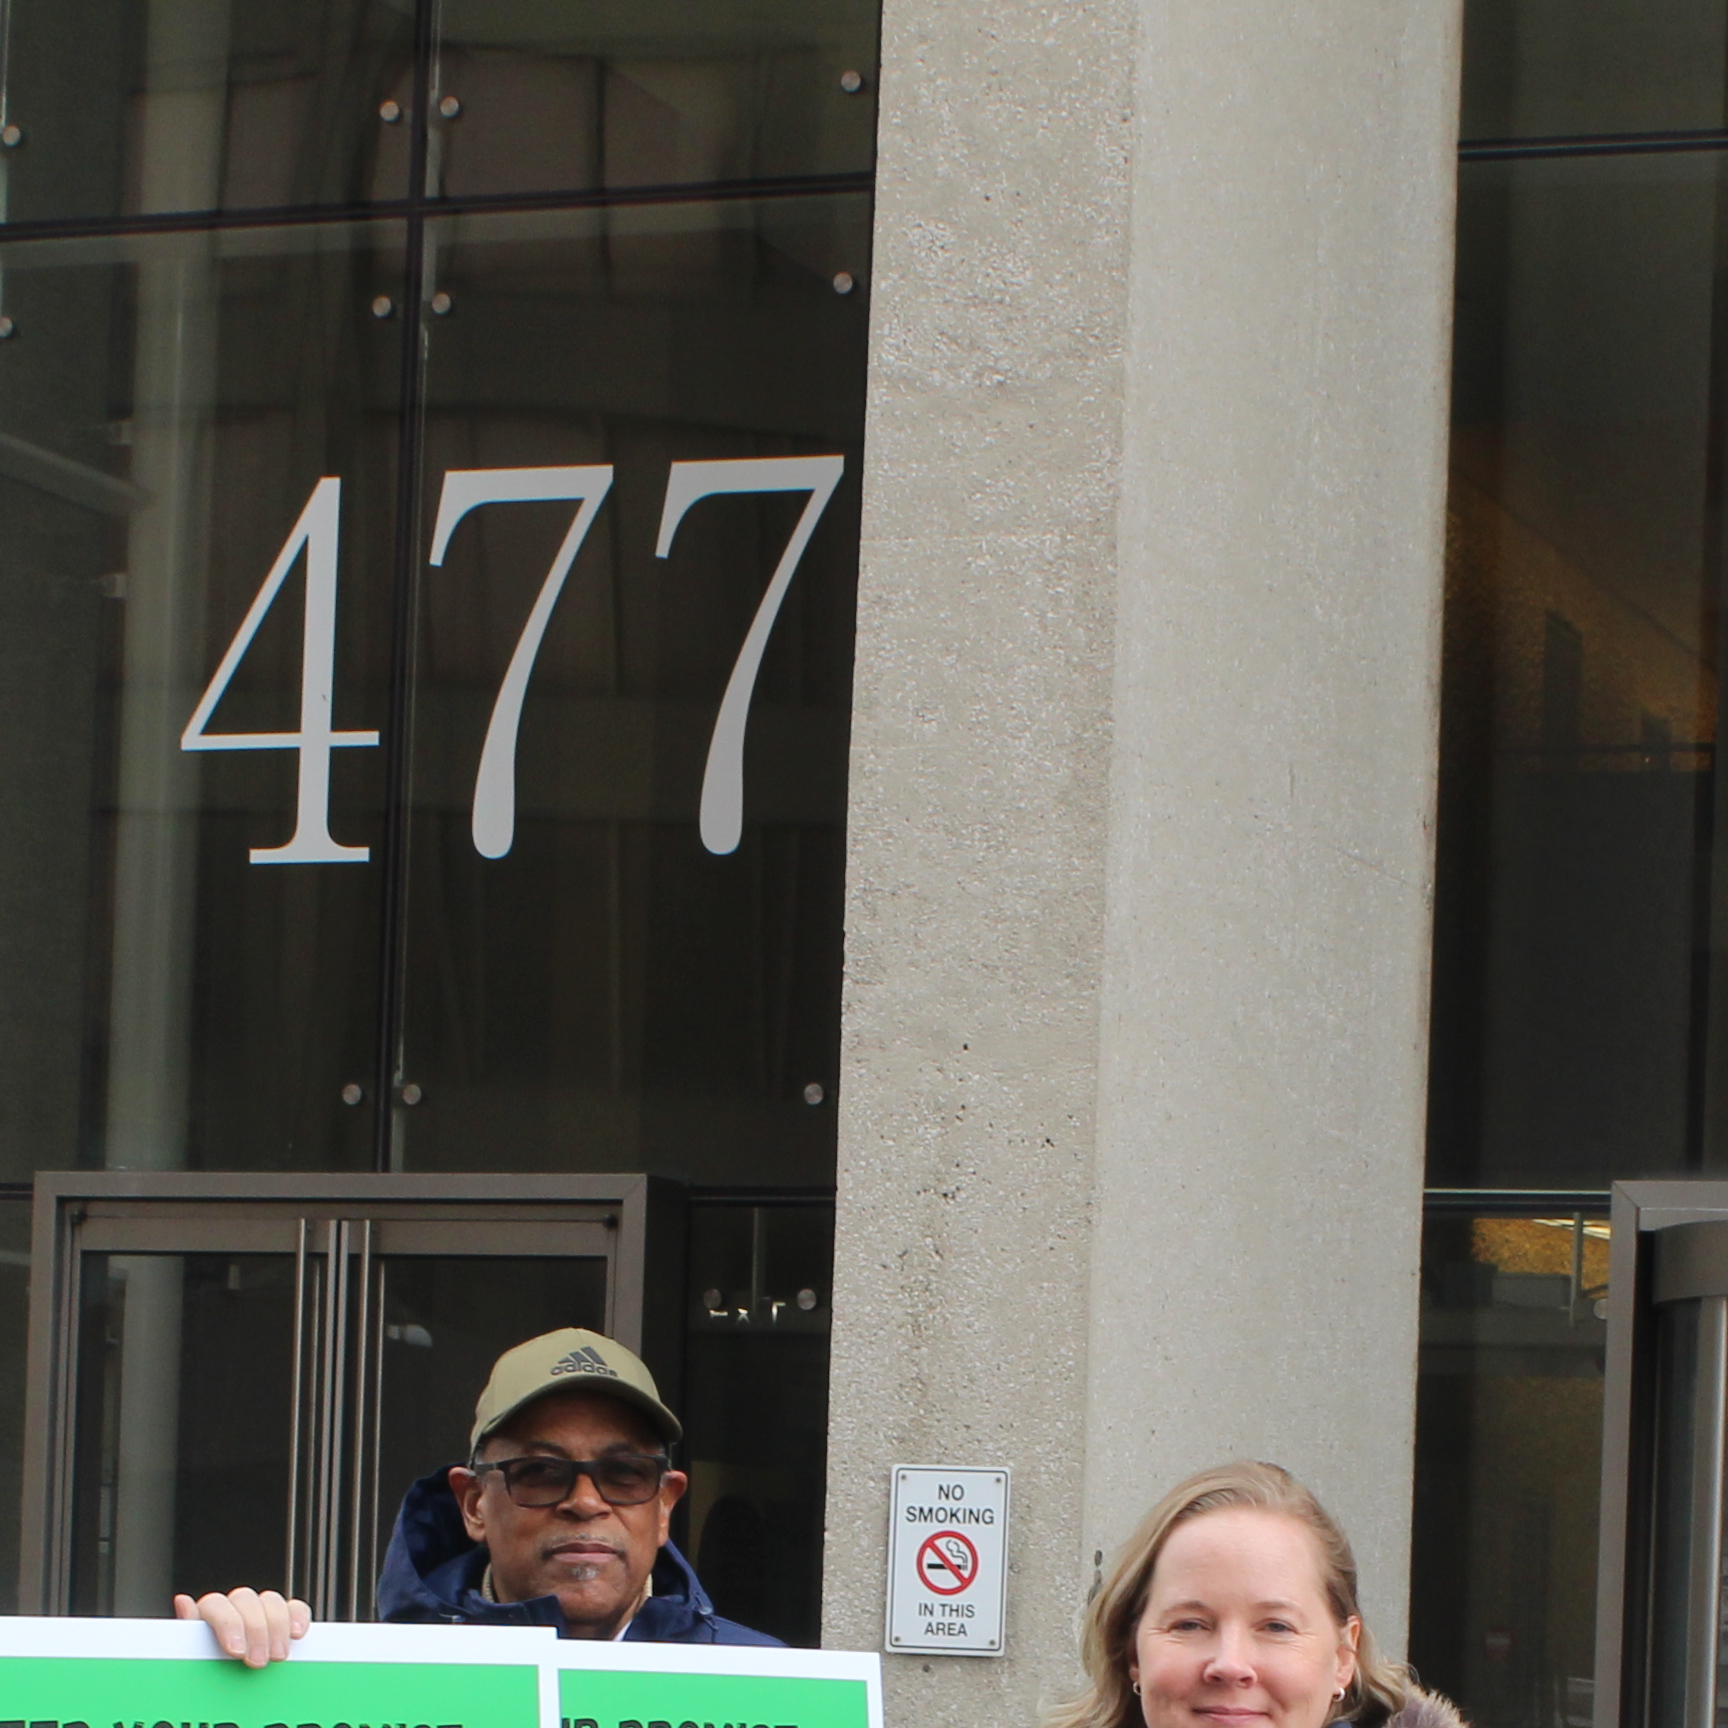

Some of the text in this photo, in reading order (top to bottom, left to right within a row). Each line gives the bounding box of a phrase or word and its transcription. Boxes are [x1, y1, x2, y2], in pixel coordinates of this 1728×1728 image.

[181, 456, 844, 865] 477
[549, 1360, 618, 1378] adidas
[937, 1484, 965, 1501] NO
[905, 1505, 995, 1525] SMOKING
[918, 1603, 975, 1619] IN THIS
[924, 1622, 968, 1637] AREA
